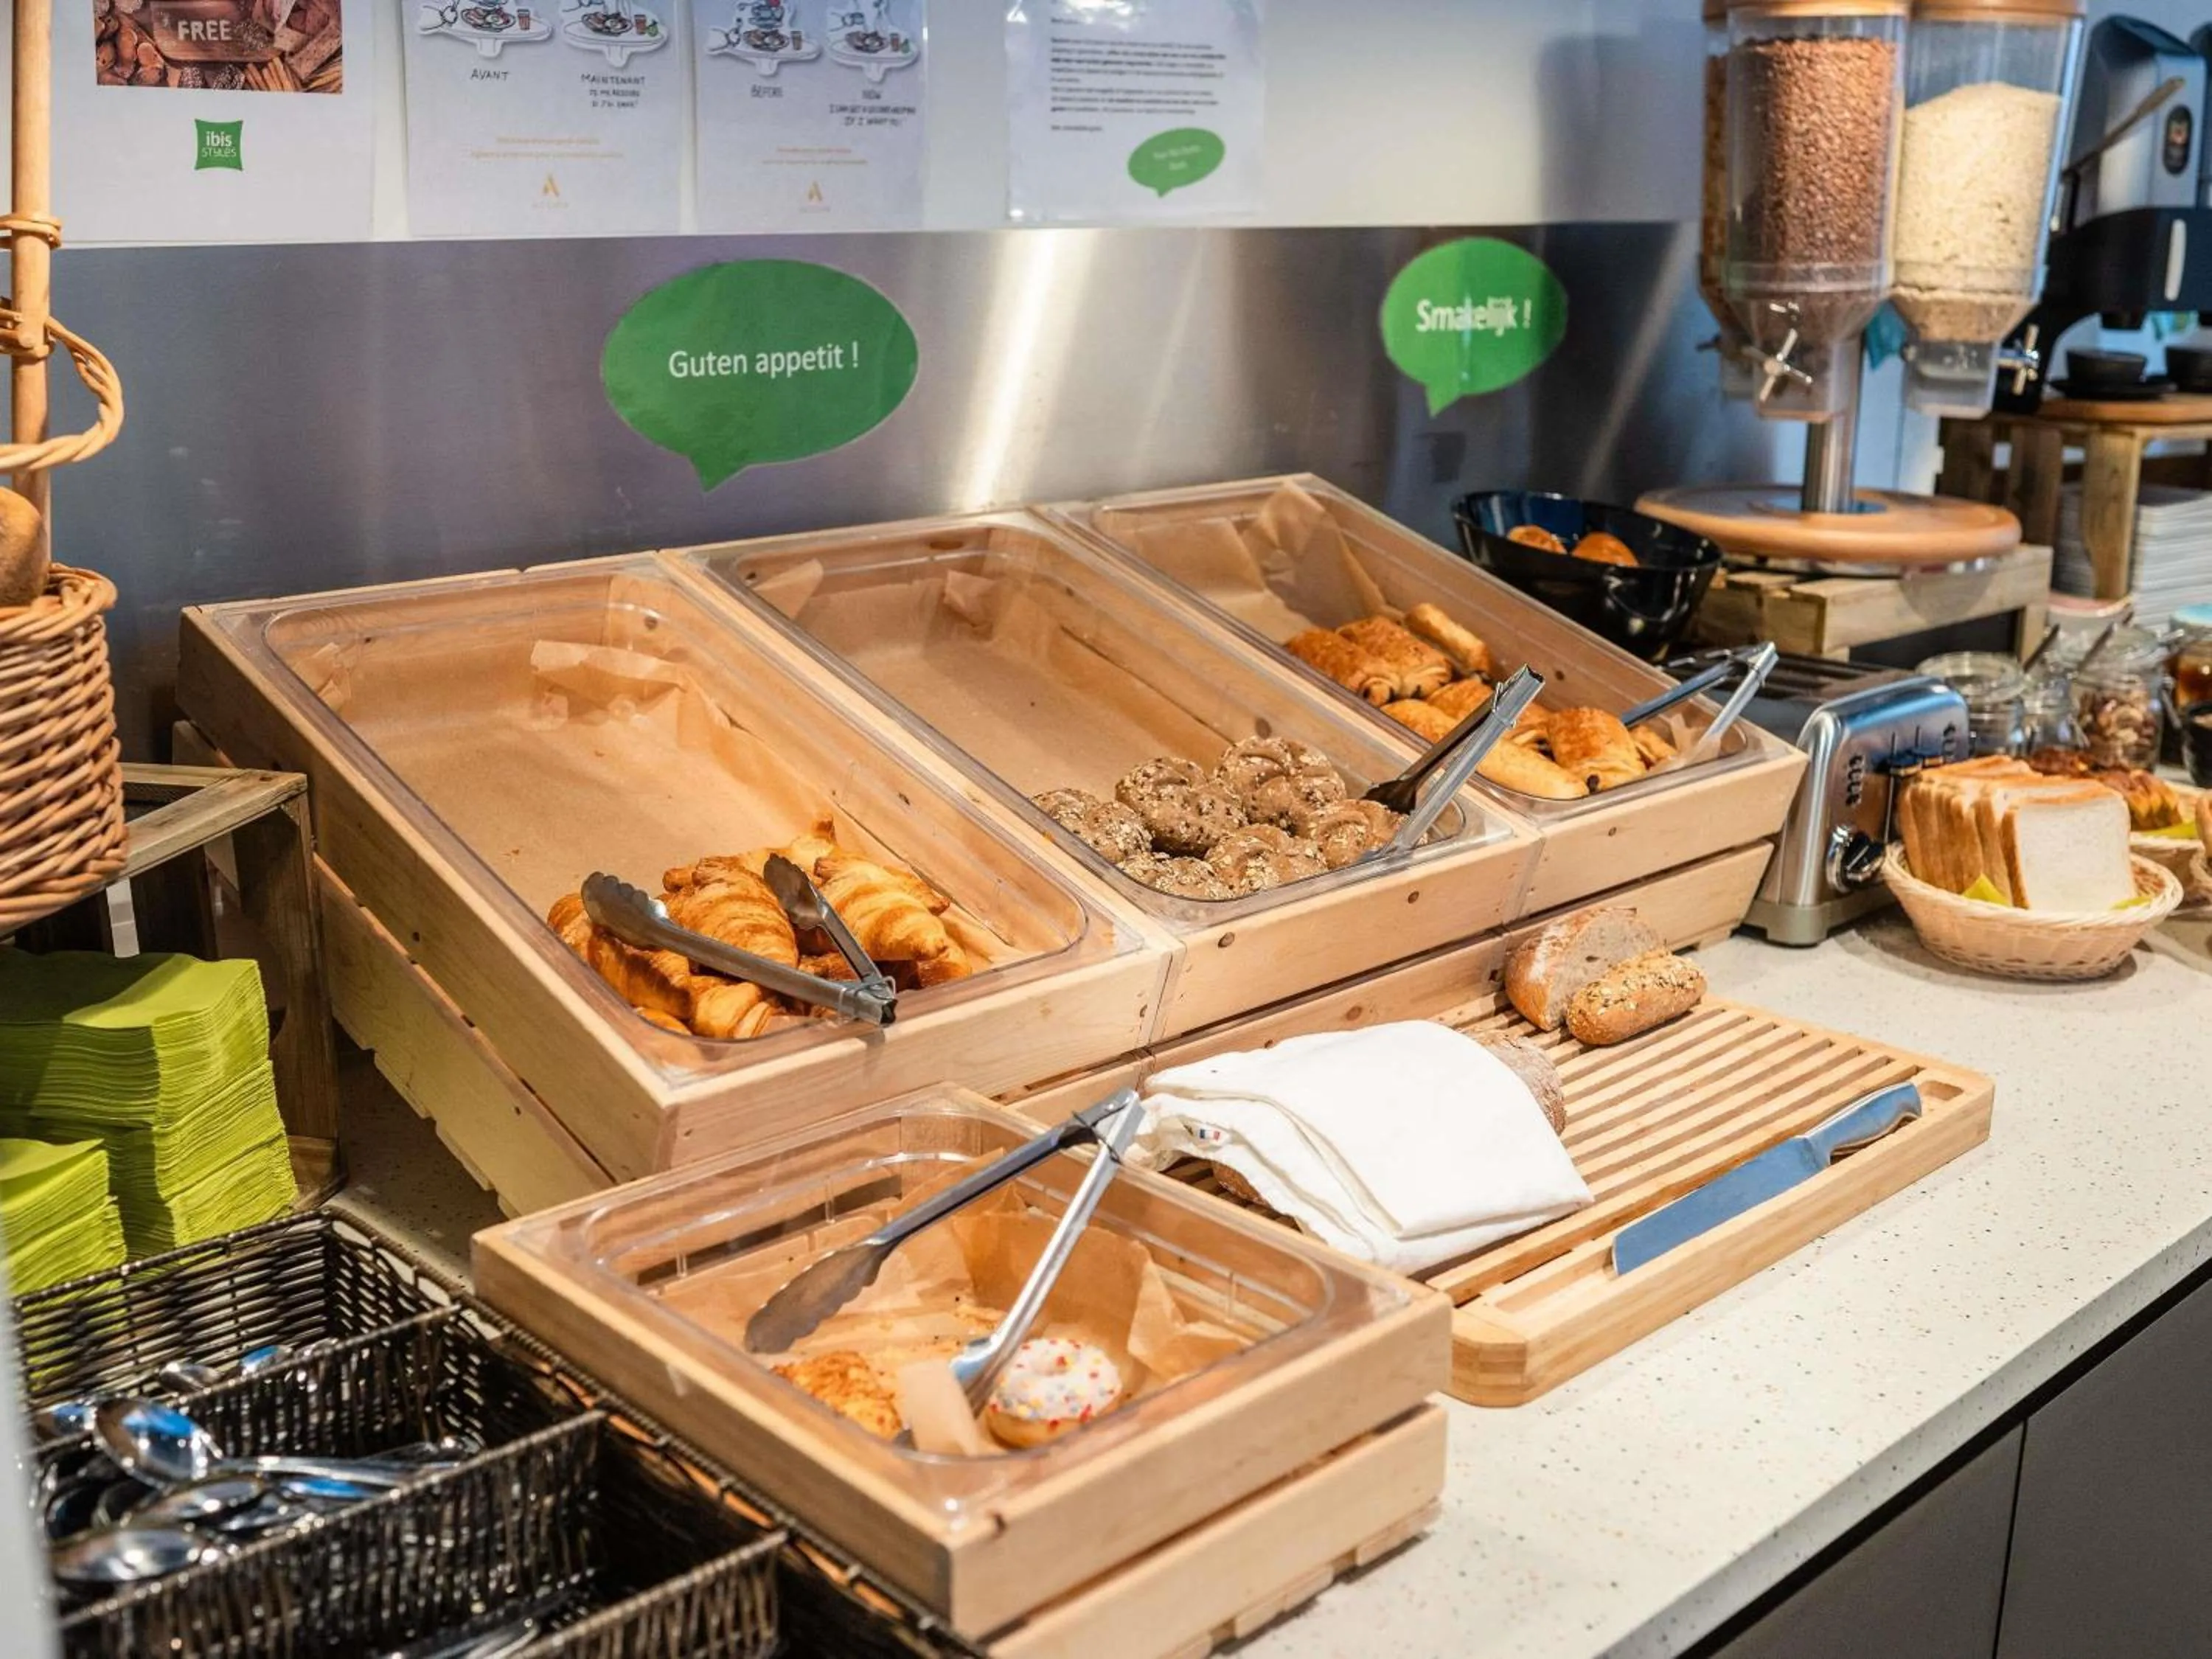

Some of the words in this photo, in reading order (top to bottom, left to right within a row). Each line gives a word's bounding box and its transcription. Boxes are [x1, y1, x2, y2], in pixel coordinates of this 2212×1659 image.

[178, 20, 232, 41] FREE
[470, 69, 509, 81] AVANT
[580, 73, 647, 86] MAINTENANT
[206, 131, 232, 147] ibis
[201, 147, 237, 157] STYLES
[669, 350, 748, 378] Guten
[756, 344, 844, 379] appetit
